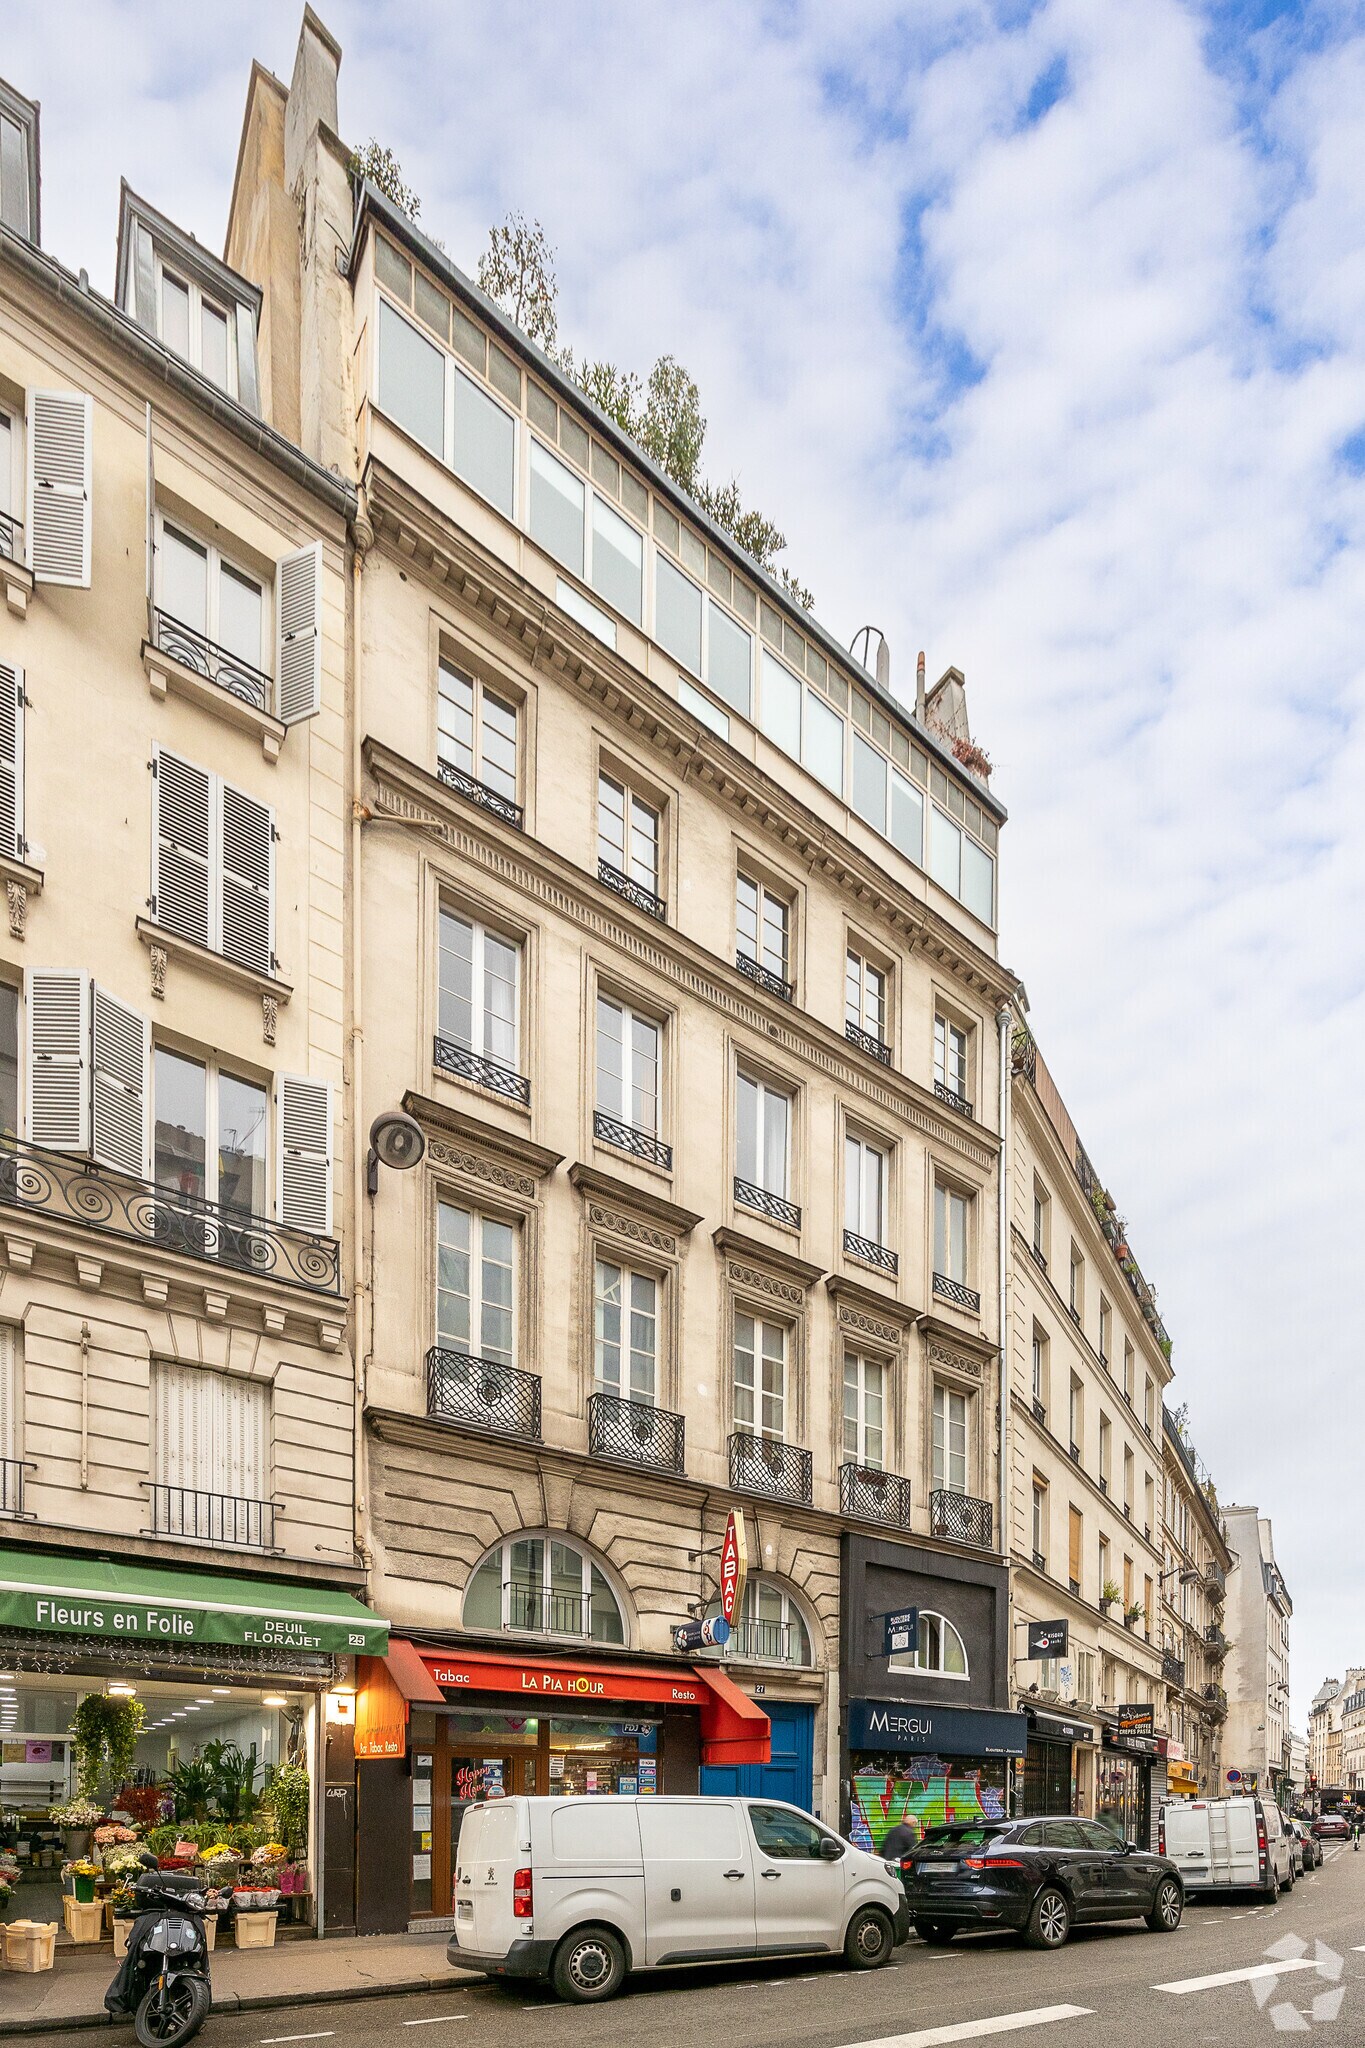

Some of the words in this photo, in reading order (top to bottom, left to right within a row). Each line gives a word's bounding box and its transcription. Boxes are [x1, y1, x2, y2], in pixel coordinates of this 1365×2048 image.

[724, 1525, 736, 1613] TABAC
[36, 1601, 105, 1628] Fleurs
[113, 1613, 138, 1631] en
[146, 1612, 194, 1636] Folie
[265, 1621, 308, 1634] DEUIL
[244, 1631, 322, 1647] FLORAJET
[350, 1635, 364, 1645] 25
[433, 1669, 470, 1684] Tabac
[671, 1689, 696, 1700] Resto
[756, 1685, 764, 1693] 27
[624, 1724, 639, 1732] FDJ
[869, 1710, 932, 1735] MERGUI
[369, 1741, 383, 1753] Tabac
[385, 1741, 398, 1753] Resto
[897, 1735, 926, 1743] PARIS
[456, 1766, 490, 1785] Happy
[459, 1782, 486, 1801] Hour
